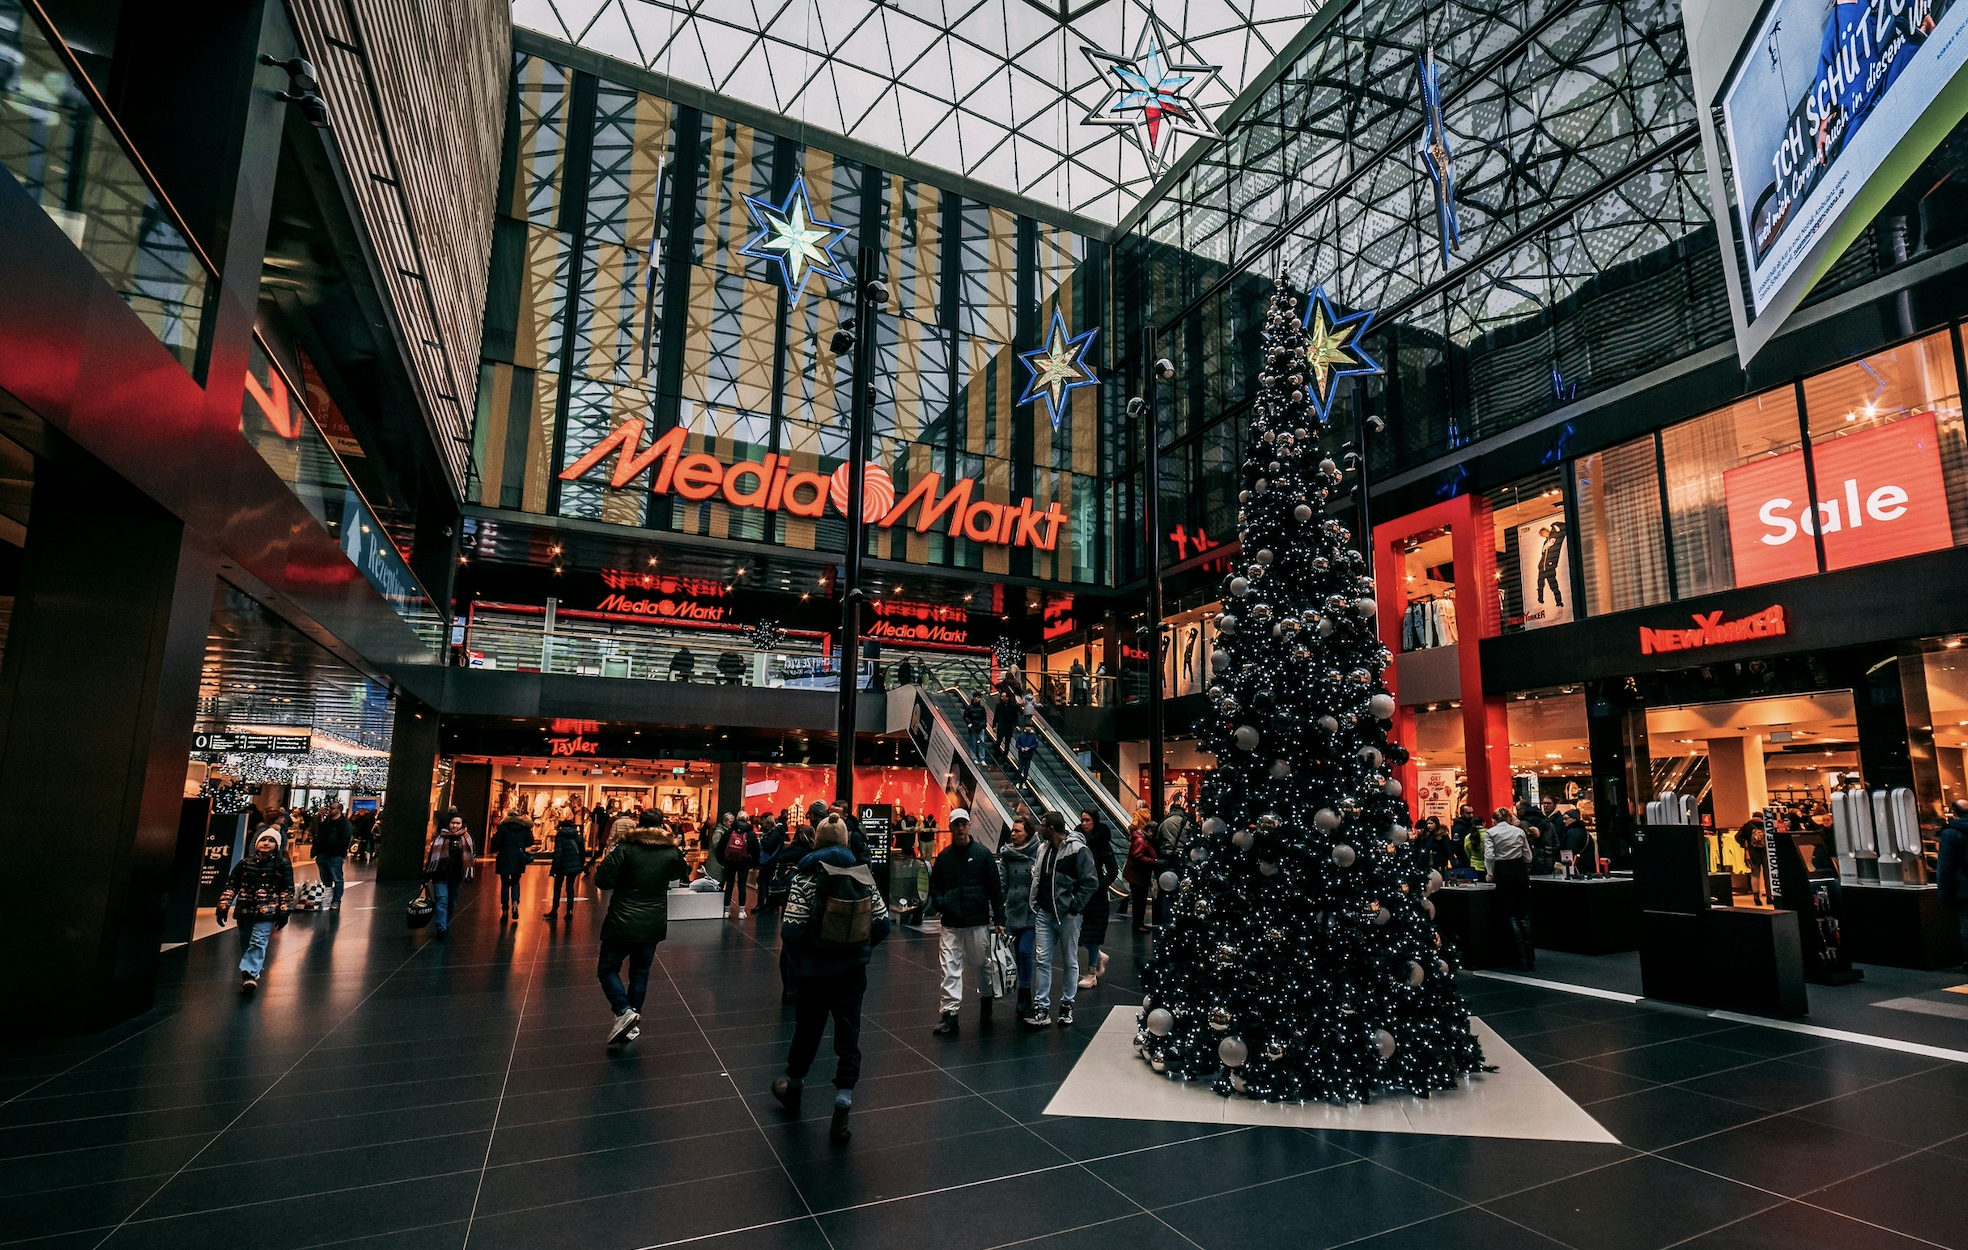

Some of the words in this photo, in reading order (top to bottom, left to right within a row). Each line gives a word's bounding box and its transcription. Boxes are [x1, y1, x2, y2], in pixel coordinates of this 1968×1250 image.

[1757, 211, 1771, 247] weil
[1772, 187, 1791, 226] mich
[1792, 148, 1823, 199] Corona
[1825, 104, 1849, 151] auch
[1852, 92, 1863, 113] in
[1866, 34, 1906, 92] diesem
[1908, 0, 1933, 35] Wi
[1773, 116, 1804, 192] ICH
[559, 419, 834, 518] Media
[879, 472, 1067, 551] Markt
[1759, 478, 1909, 546] Sale
[368, 533, 405, 609] Rezeption
[596, 593, 660, 615] Media
[671, 600, 725, 620] Markt
[867, 620, 915, 639] Media
[926, 625, 968, 643] Markt
[548, 736, 599, 757] Tayler
[204, 845, 230, 860] rgt
[1768, 850, 1778, 872] YOU
[1771, 872, 1782, 896] ARE
